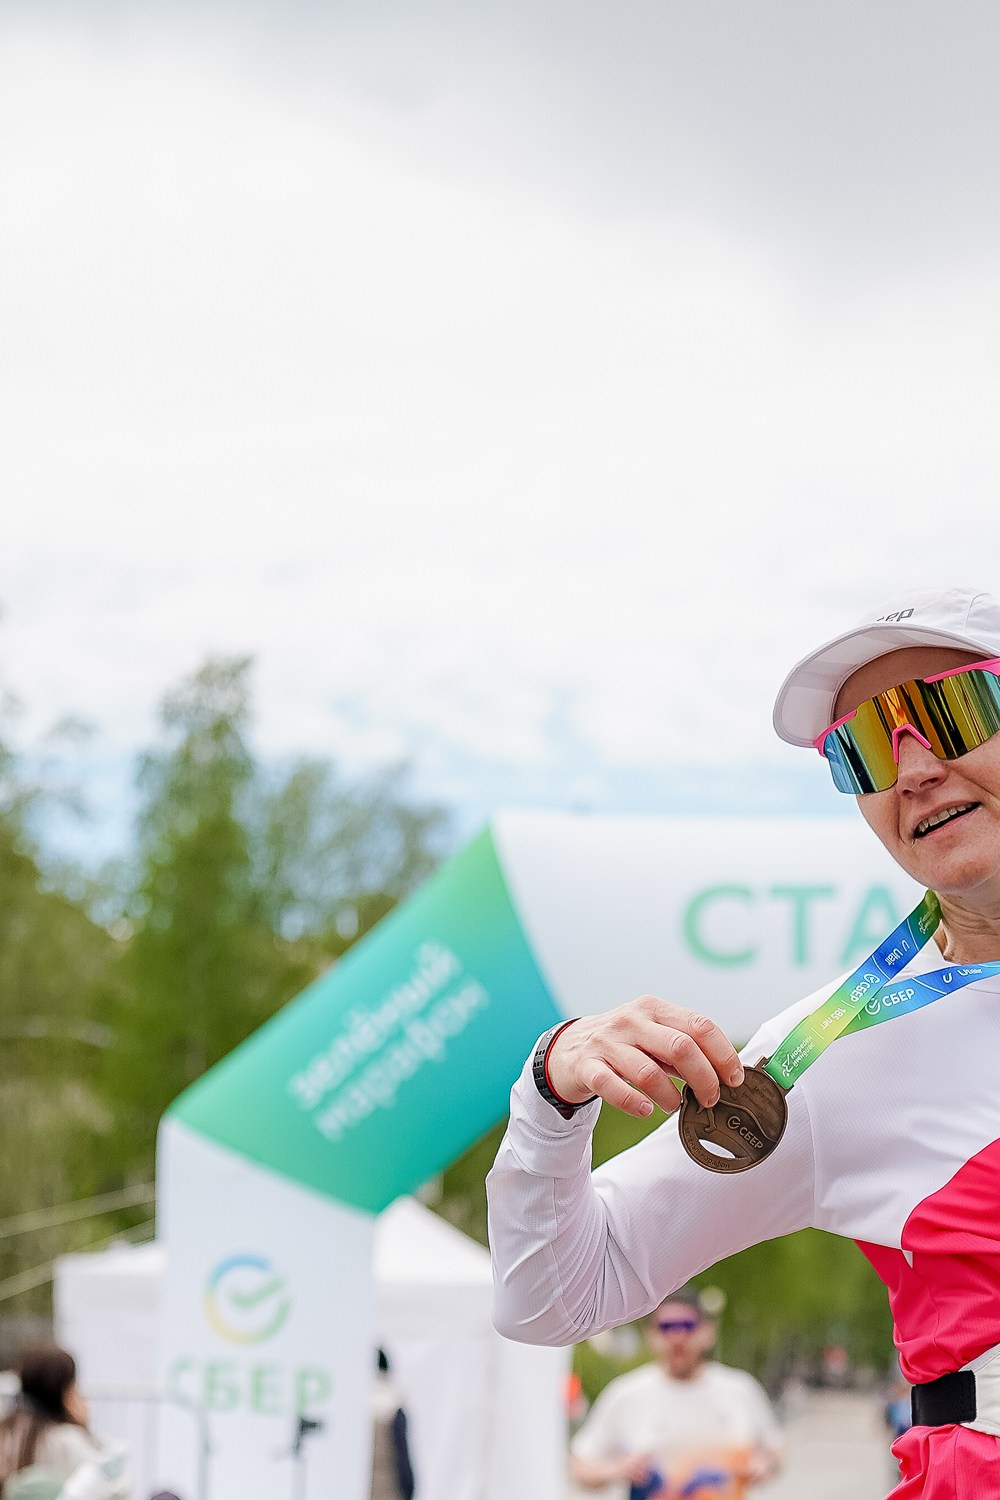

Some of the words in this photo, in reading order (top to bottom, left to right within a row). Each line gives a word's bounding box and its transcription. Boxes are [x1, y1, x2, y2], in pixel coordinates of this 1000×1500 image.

[884, 948, 903, 966] Utair
[849, 981, 870, 1003] СБЕР
[882, 988, 915, 1007] СБЕР
[819, 1016, 833, 1030] лет
[832, 1007, 846, 1021] 185
[739, 1126, 763, 1150] СБЕР
